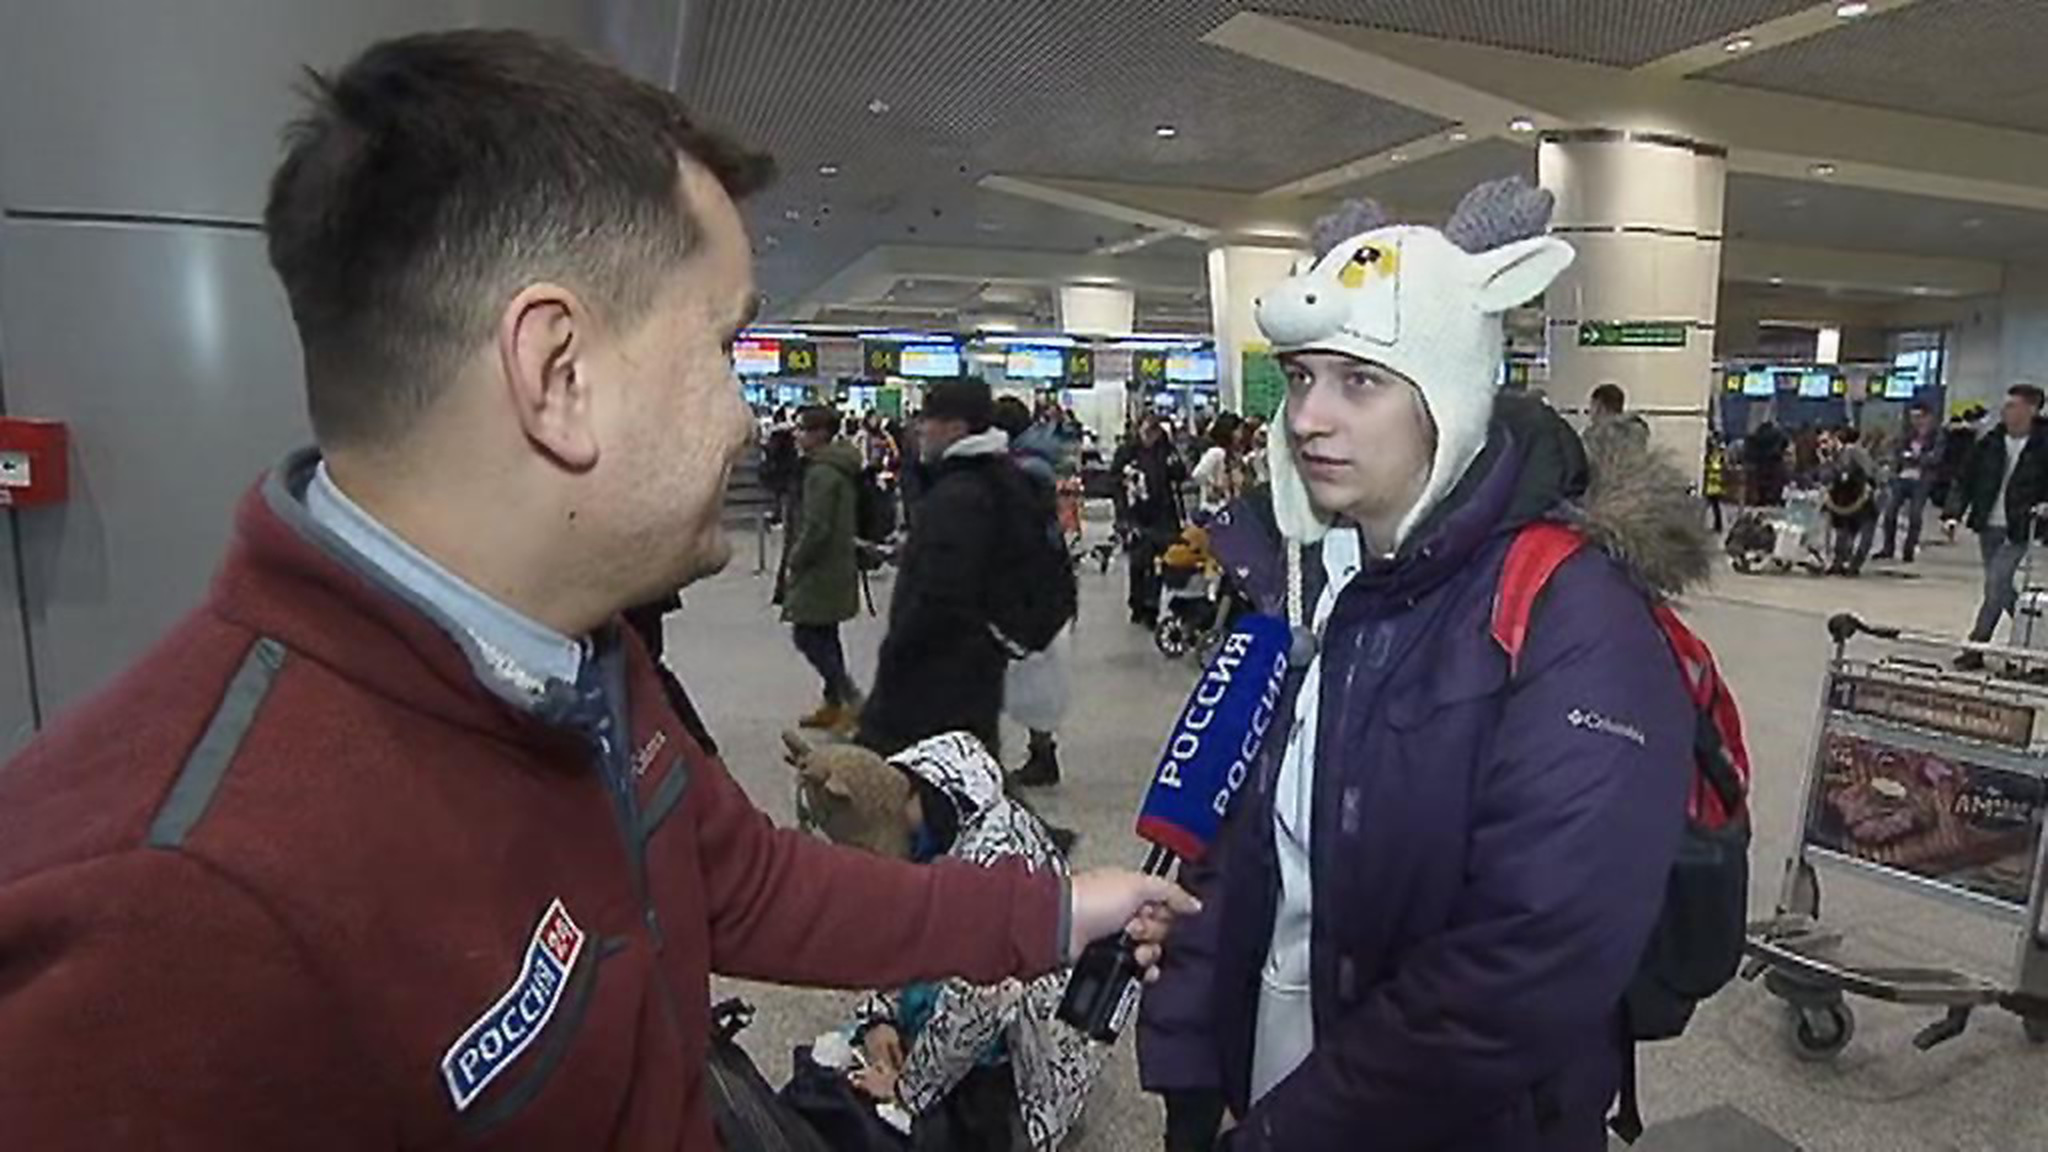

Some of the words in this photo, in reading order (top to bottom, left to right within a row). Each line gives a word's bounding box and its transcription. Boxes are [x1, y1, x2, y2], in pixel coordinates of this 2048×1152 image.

[1158, 633, 1254, 788] РОССИЯ
[1213, 652, 1288, 816] РОССИЯ
[459, 957, 557, 1085] РОССИЯ
